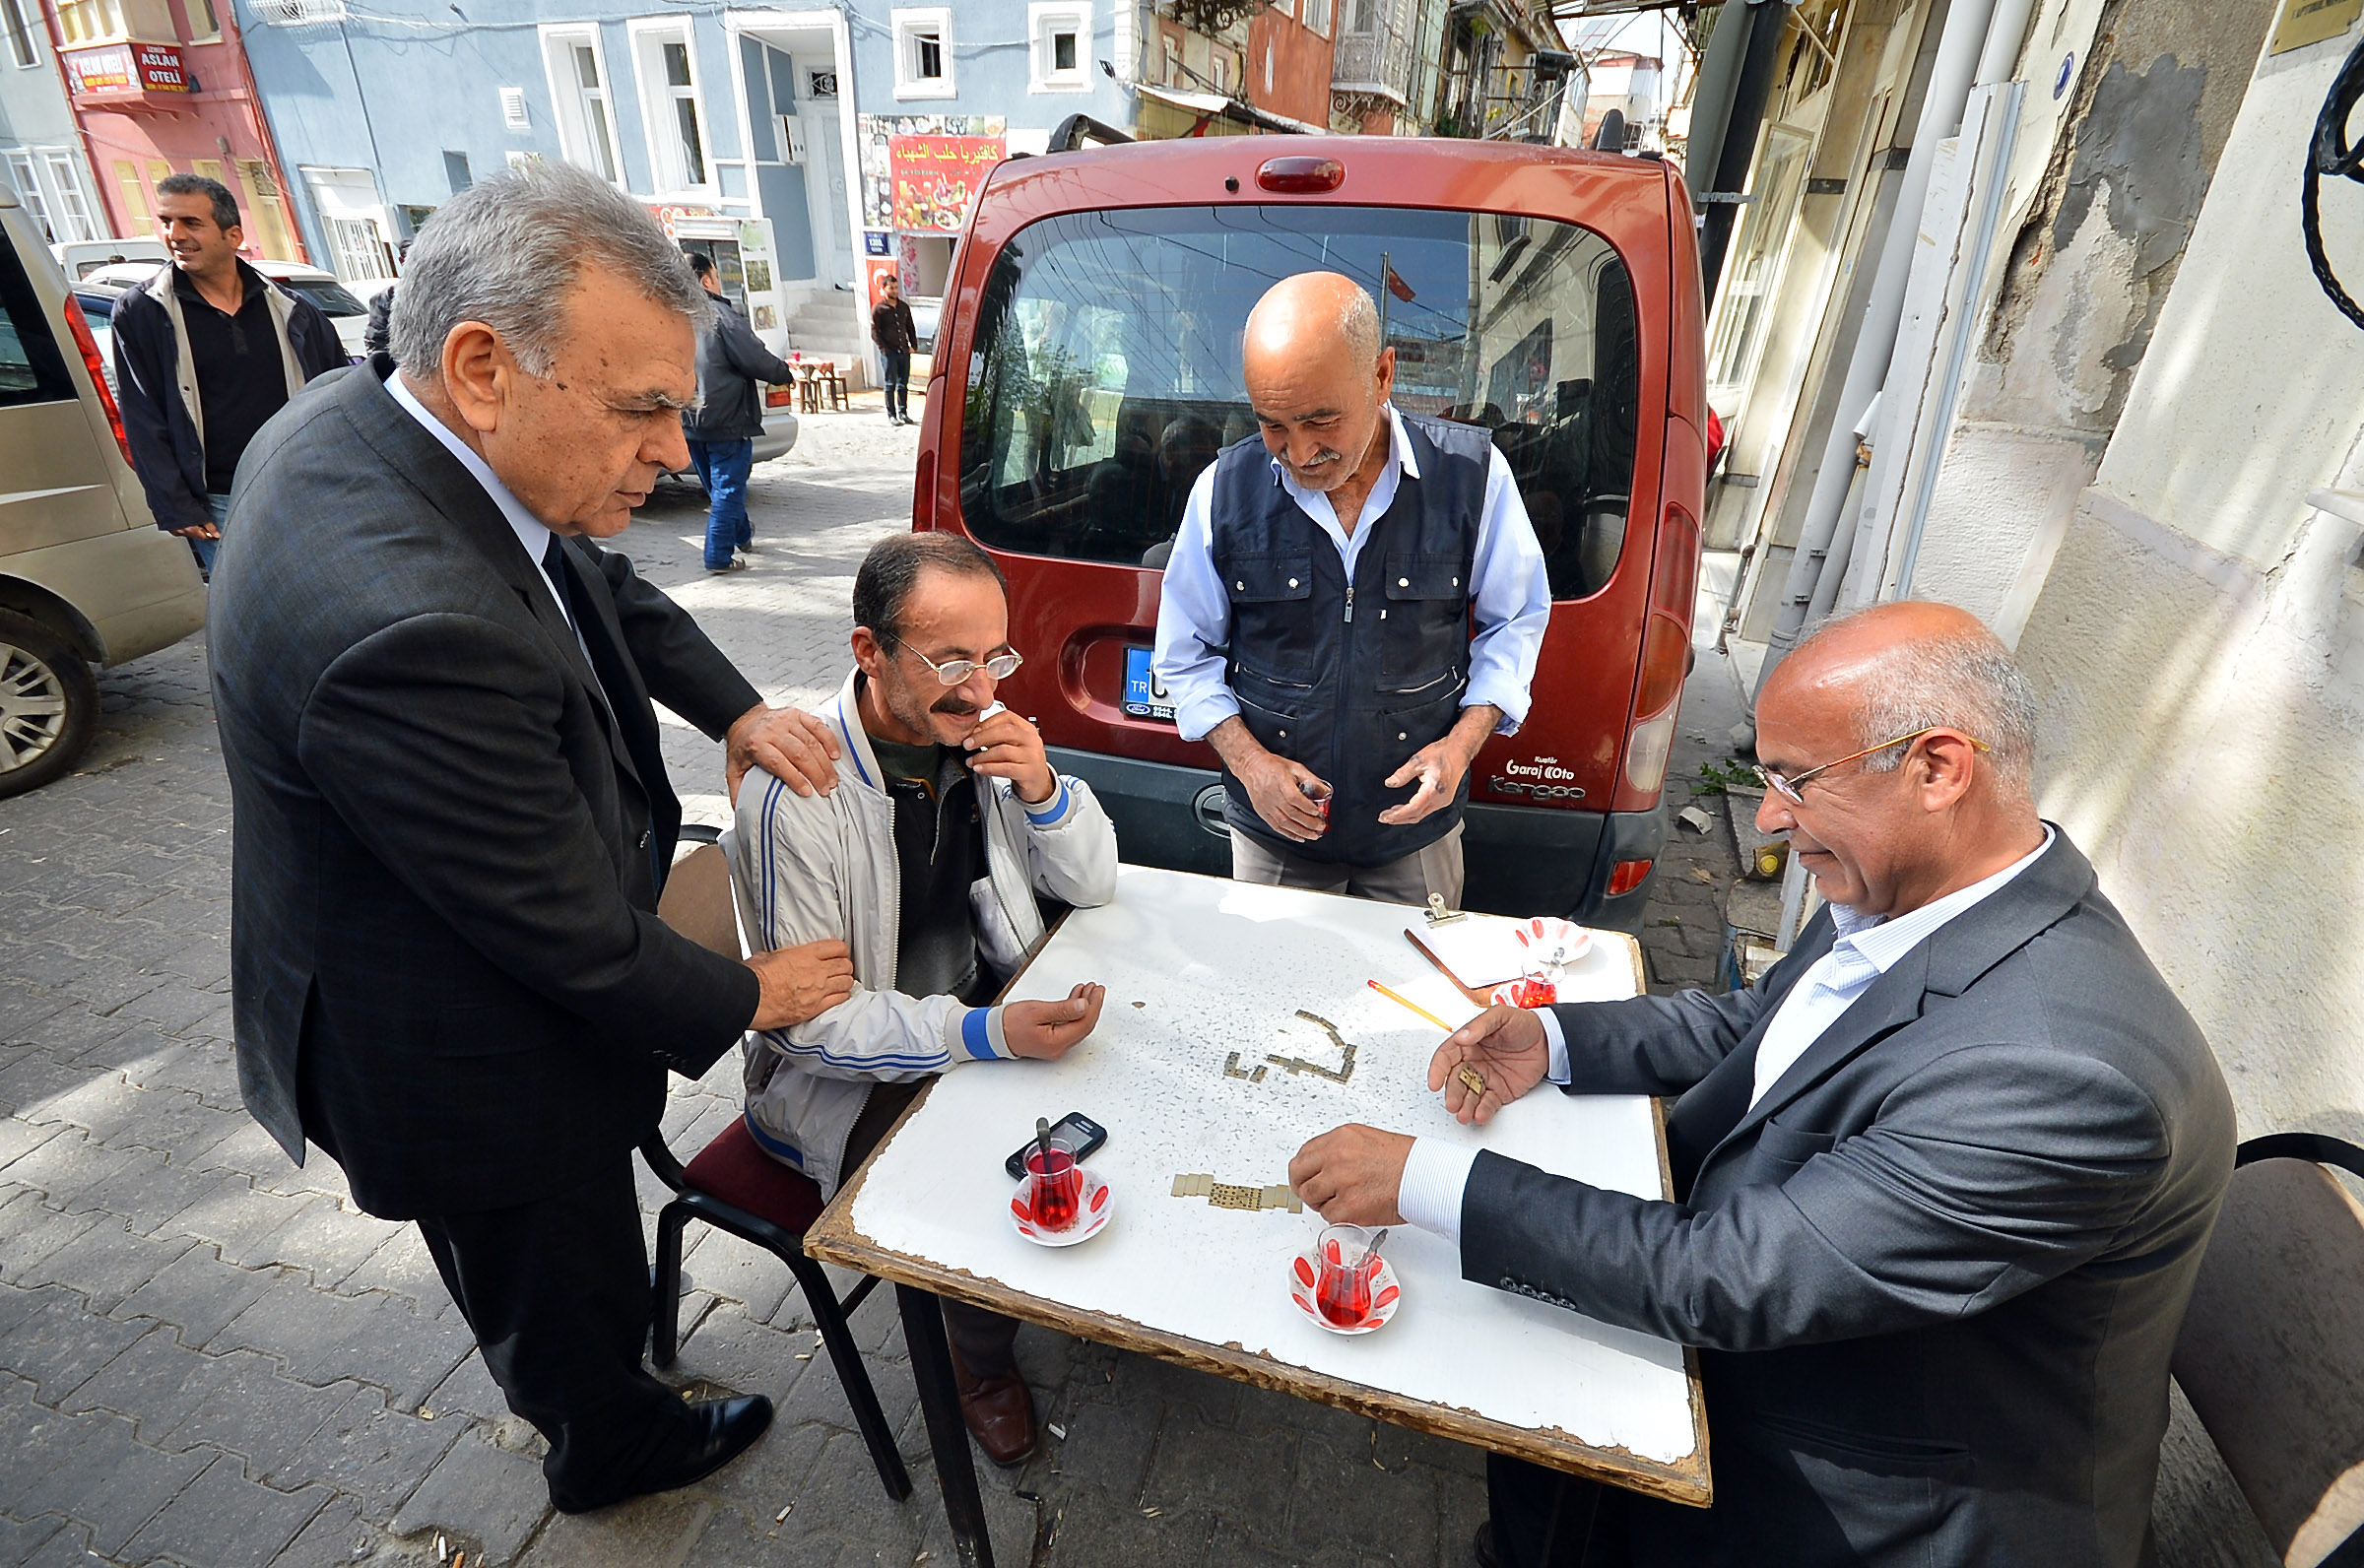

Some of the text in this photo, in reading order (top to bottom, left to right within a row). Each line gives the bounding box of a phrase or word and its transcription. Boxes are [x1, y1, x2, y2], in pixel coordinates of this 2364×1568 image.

[142, 53, 179, 67] ASLAN
[150, 70, 181, 84] OTELİ
[896, 144, 998, 163] كافتيريا حلب الشهباء
[1131, 680, 1148, 694] TR
[1506, 759, 1543, 780] Garaj
[1488, 774, 1586, 800] Kangoo
